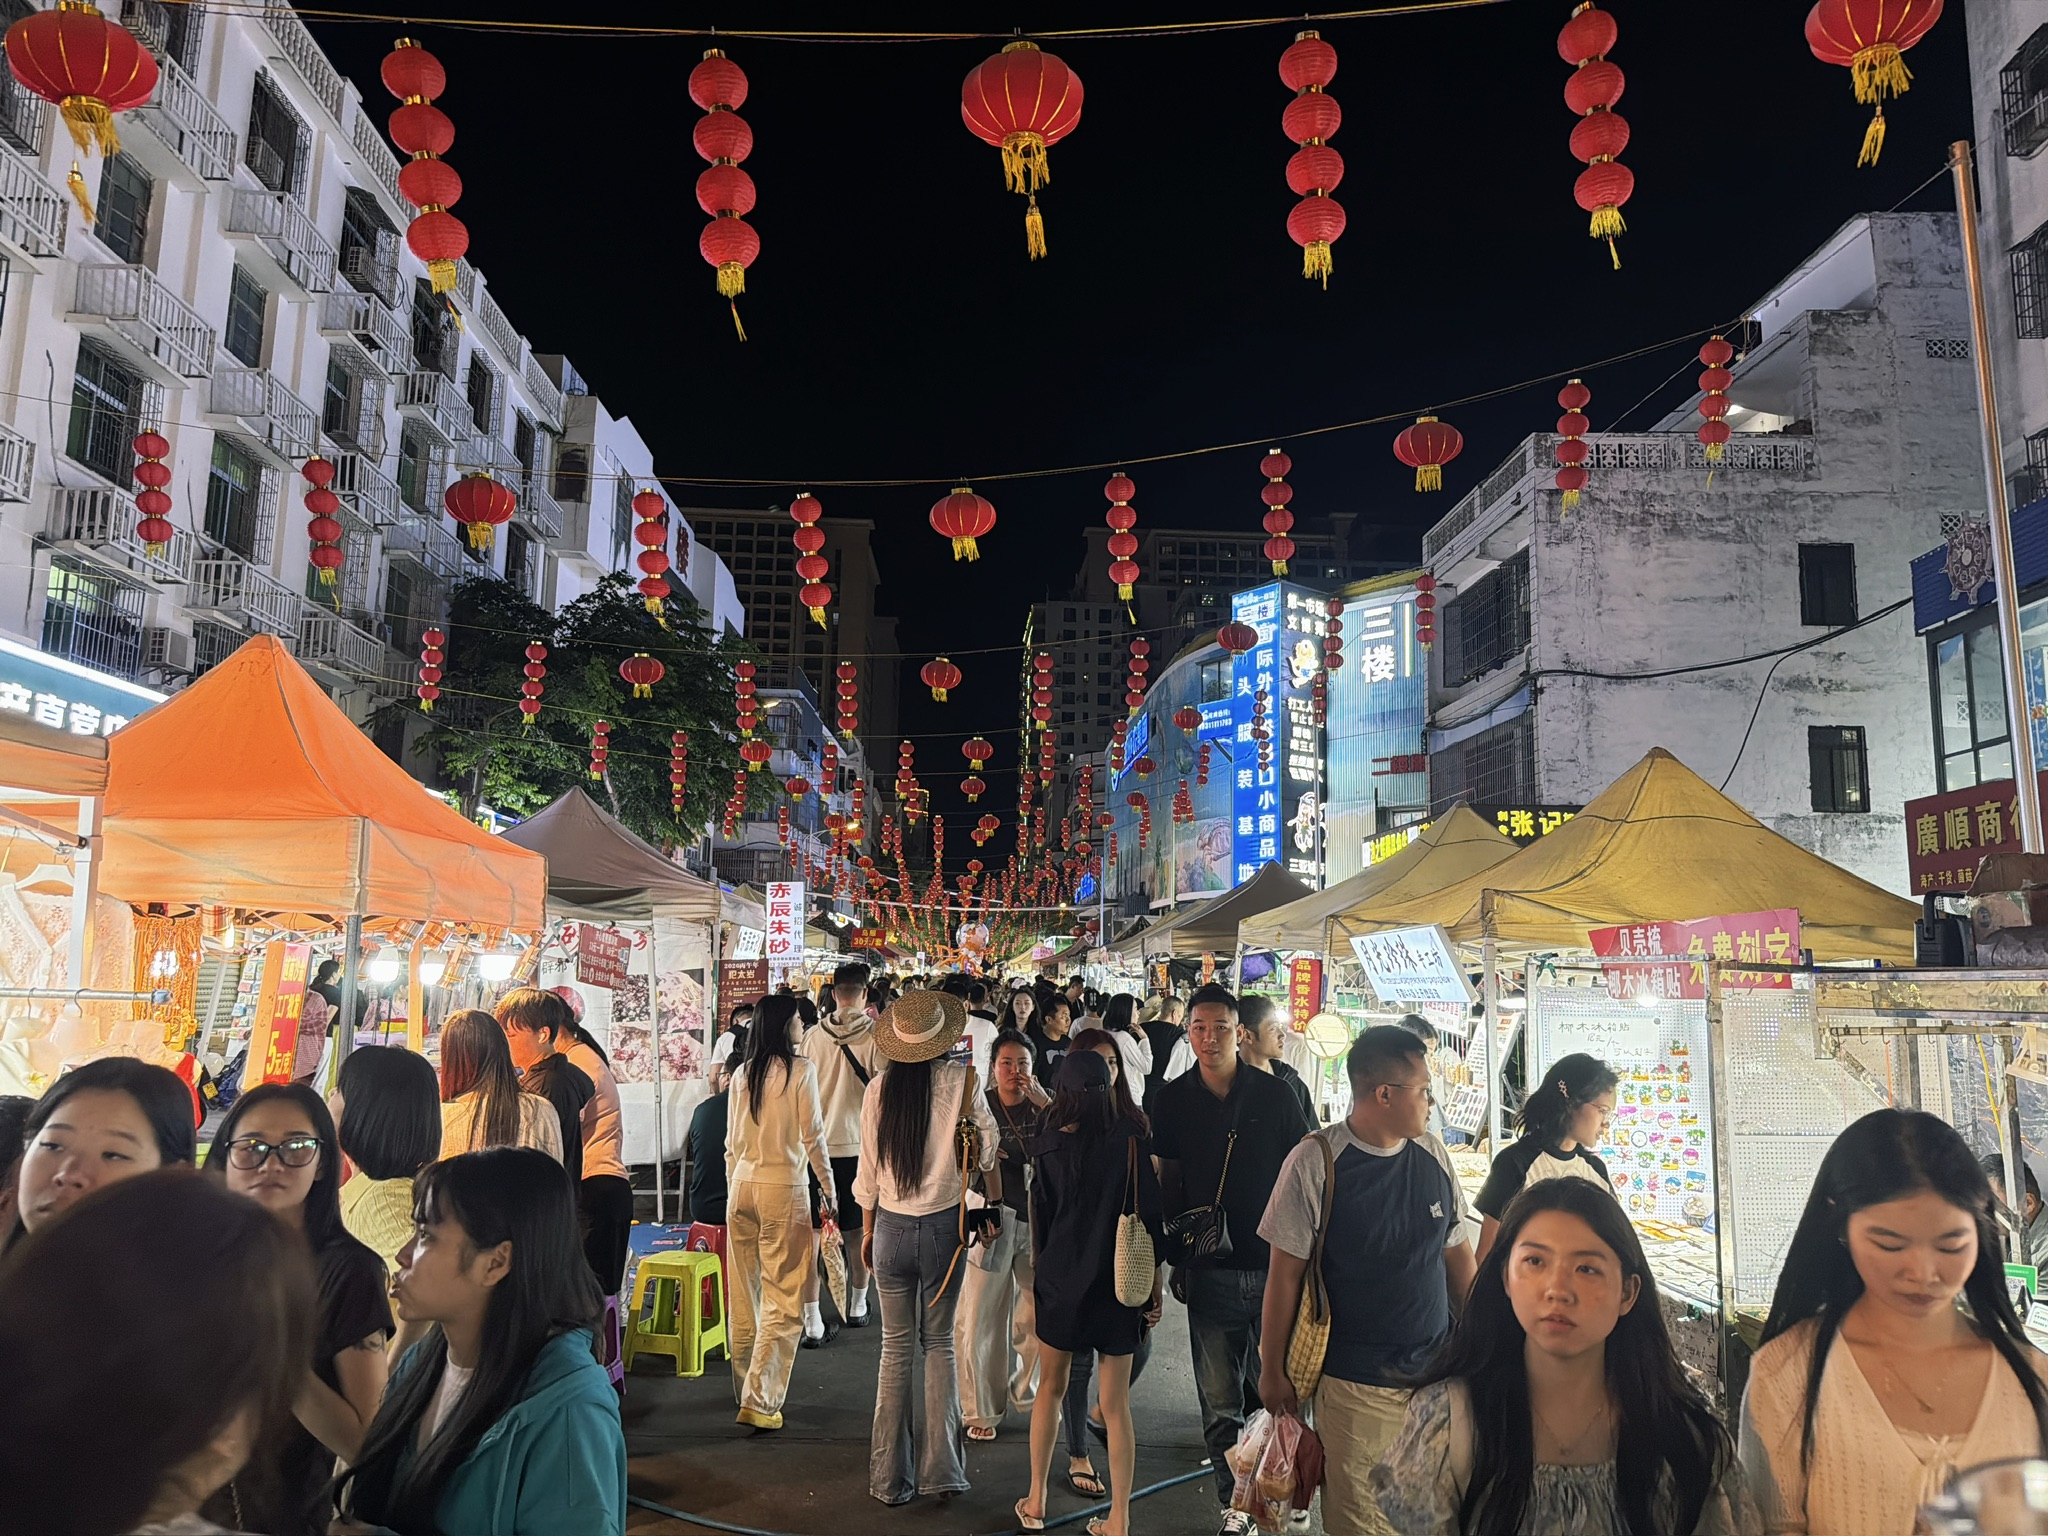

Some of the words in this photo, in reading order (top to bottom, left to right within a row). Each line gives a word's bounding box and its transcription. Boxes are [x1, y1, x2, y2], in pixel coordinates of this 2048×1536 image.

[1361, 605, 1396, 684] 三楼
[768, 882, 792, 955] 赤辰朱砂
[793, 902, 803, 954] 诚招代理
[1619, 925, 1663, 956] 贝壳梳
[728, 969, 756, 980] 犯太岁
[1607, 965, 1682, 999] 椰木冰箱贴
[1687, 926, 1793, 985] 免费刻字
[1292, 959, 1312, 1032] 品牌香水特价
